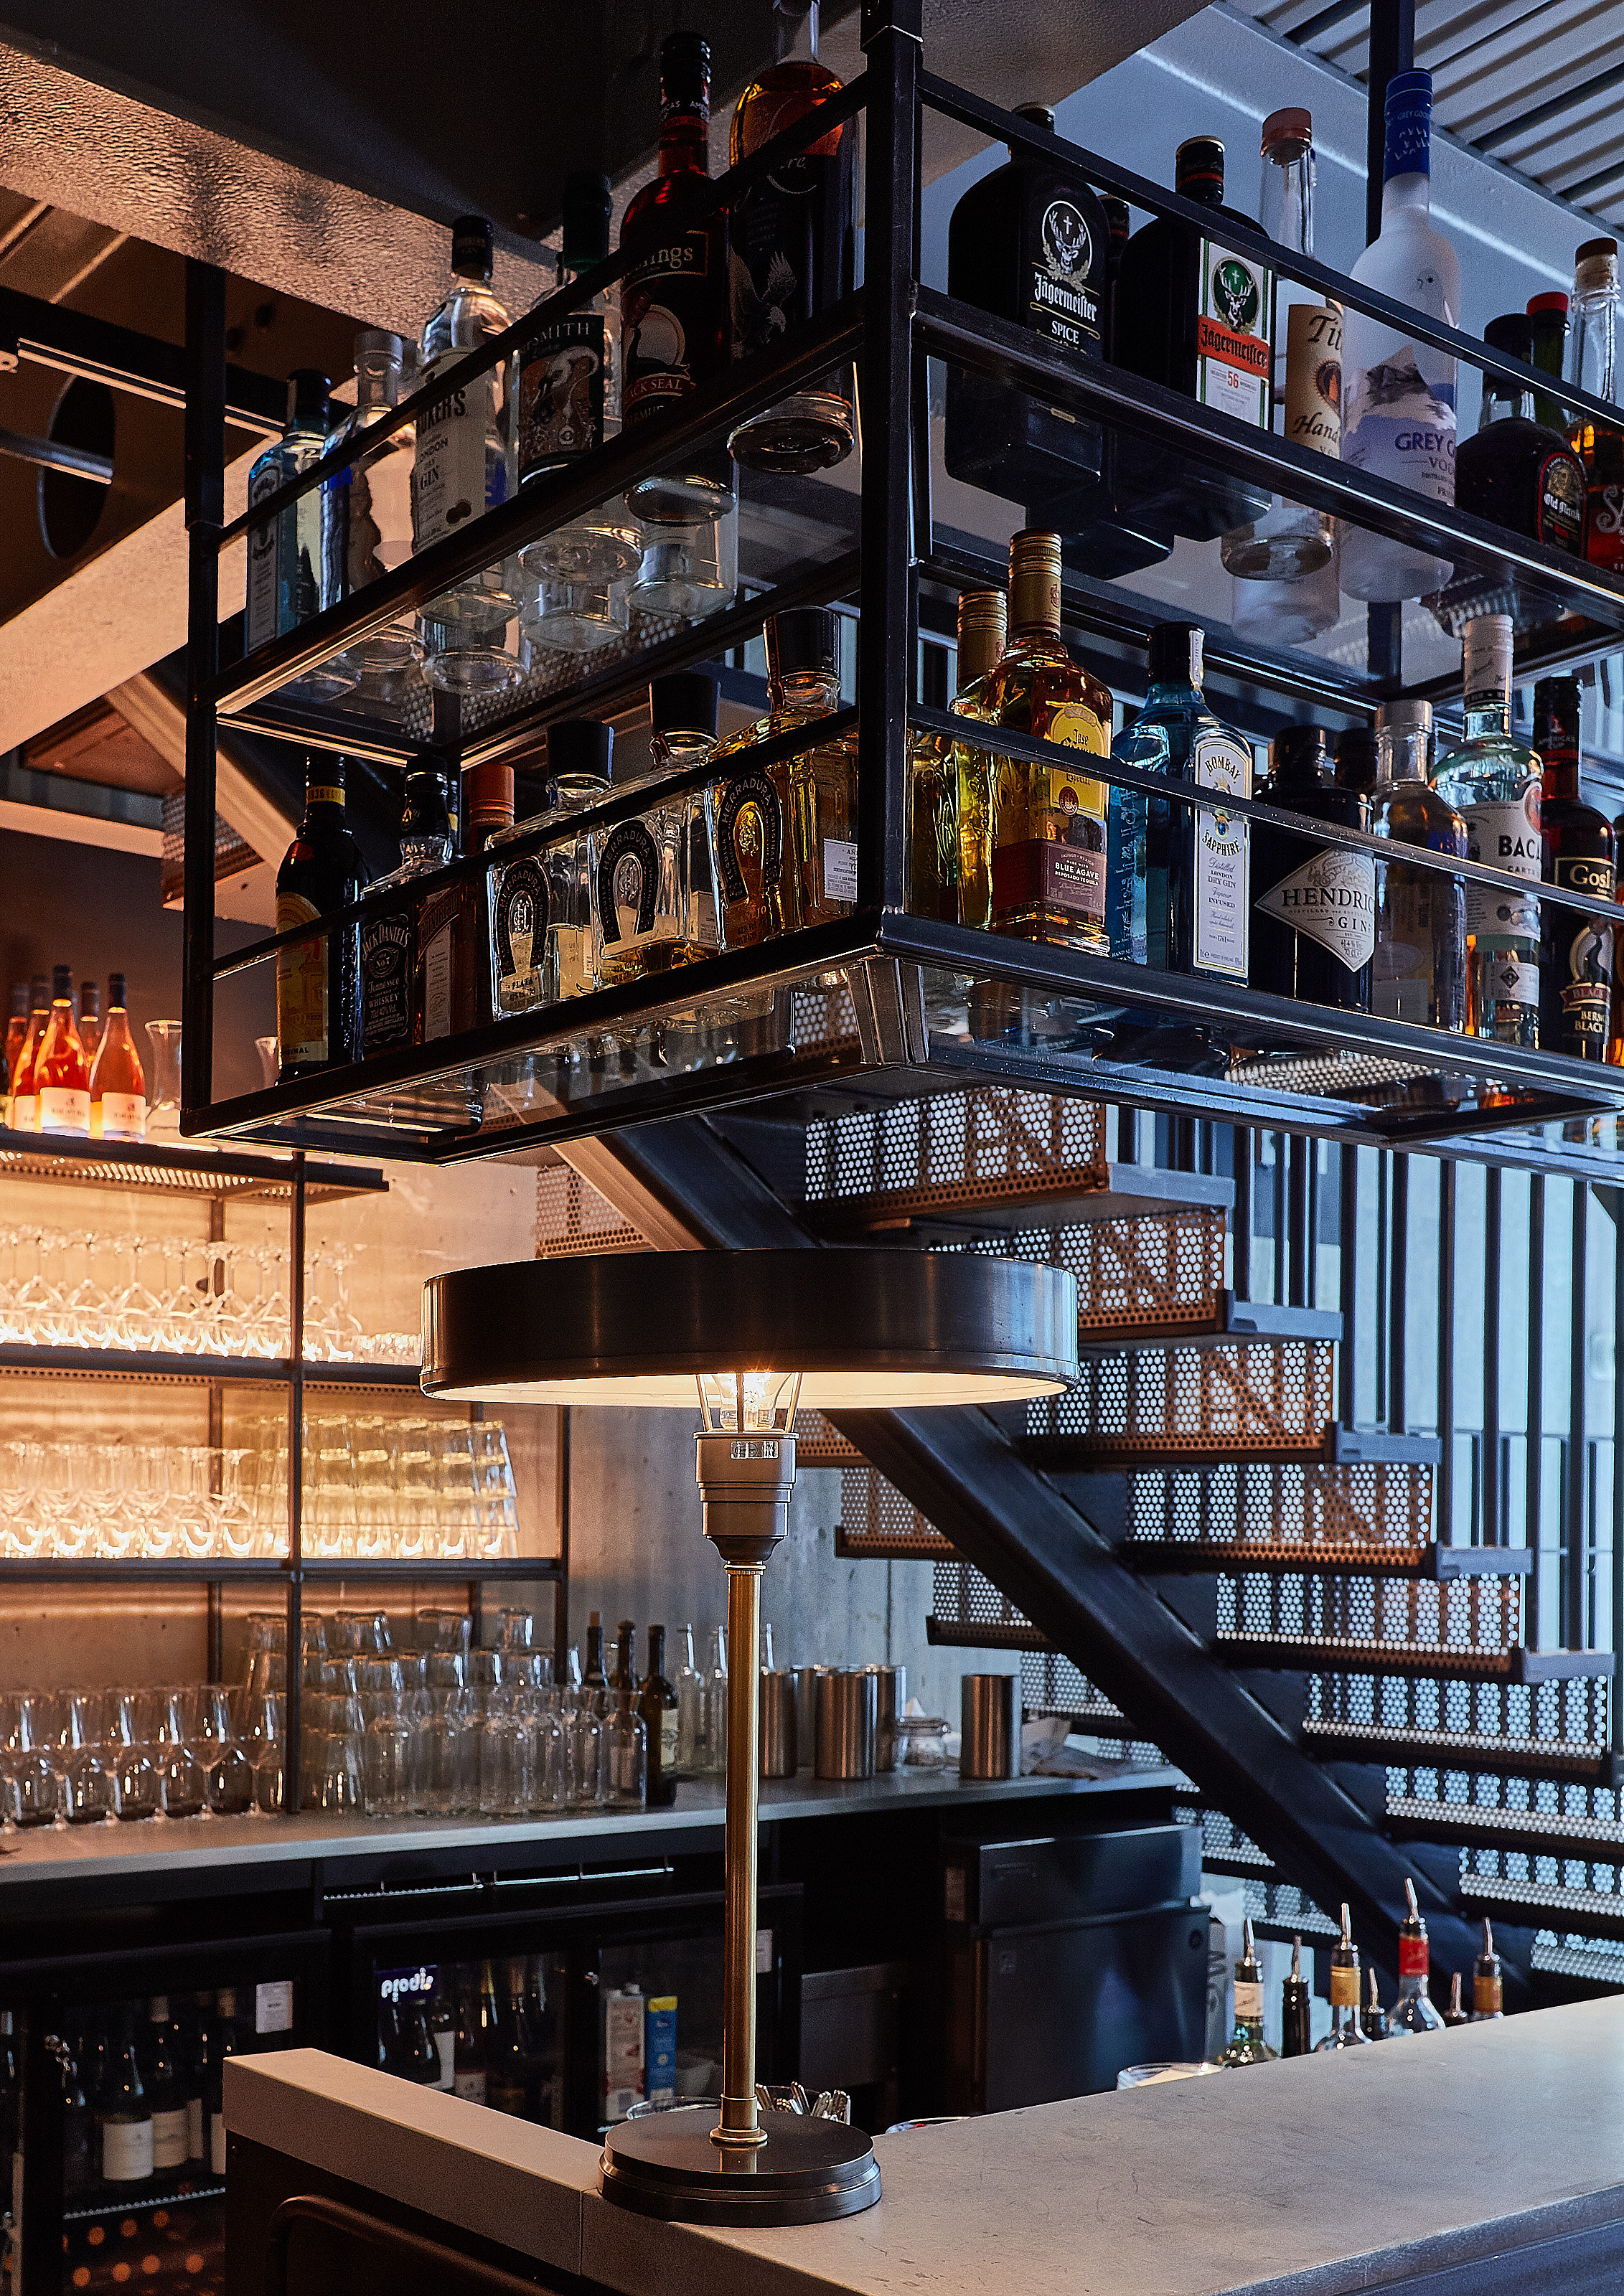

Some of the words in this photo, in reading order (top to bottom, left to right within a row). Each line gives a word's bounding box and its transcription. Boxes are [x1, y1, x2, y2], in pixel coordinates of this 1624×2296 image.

[1051, 320, 1080, 344] SPICE
[1308, 314, 1341, 350] Tit
[651, 377, 683, 390] SEAL
[1227, 370, 1239, 388] 56
[1394, 432, 1445, 453] GREY
[1204, 755, 1242, 784] BOMBAY
[721, 777, 771, 825] HERRADURA
[602, 828, 650, 871] HERRADURA
[1201, 828, 1241, 857] SAPPHIRE
[1055, 862, 1075, 873] BLUE
[1076, 867, 1099, 880] AGAVE
[1208, 856, 1236, 873] Distilled
[1054, 870, 1080, 883] REPOSADO
[1080, 877, 1099, 887] TEQUILA
[1208, 875, 1222, 885] DRY
[1222, 879, 1236, 889] GIN
[1211, 870, 1234, 880] LONDON
[1569, 864, 1612, 889] Gosl
[1208, 897, 1236, 909] INFUSED
[1282, 887, 1374, 914] HENDRIC
[1338, 916, 1368, 933] GIN
[378, 923, 412, 948] DANIEL'S
[368, 993, 400, 1009] WHISKEY
